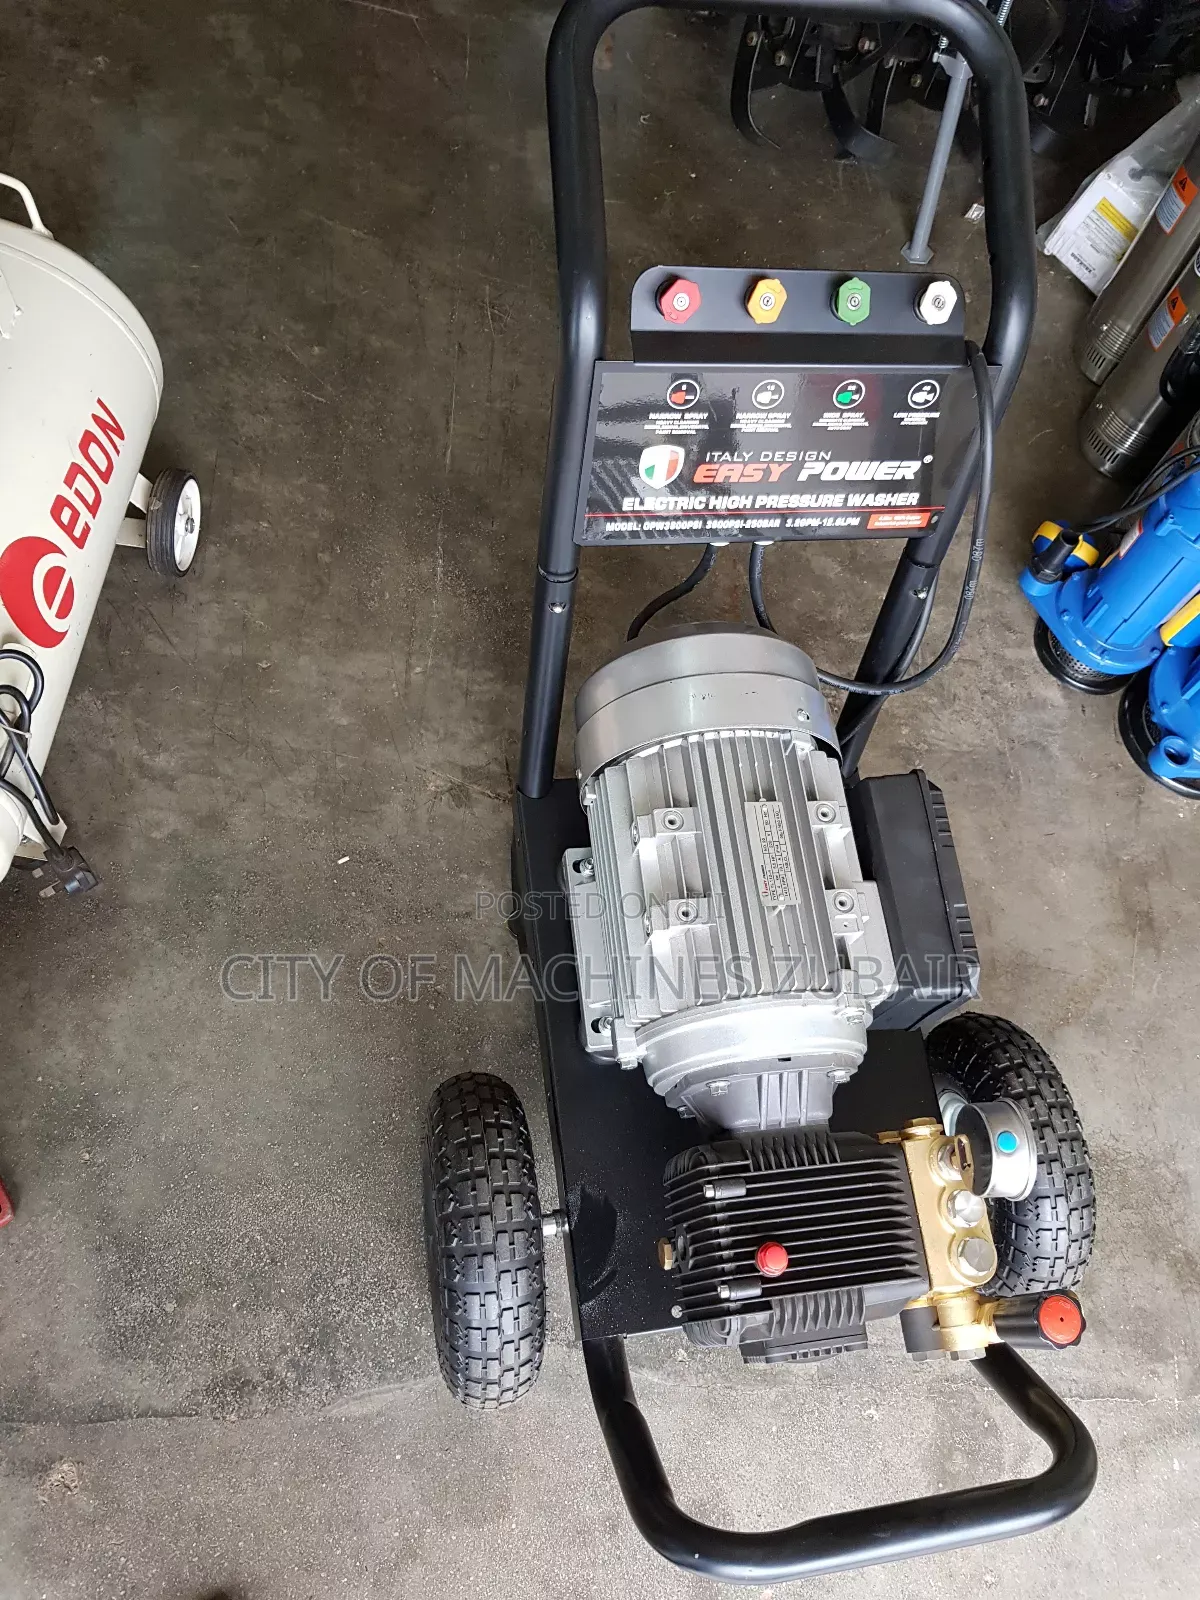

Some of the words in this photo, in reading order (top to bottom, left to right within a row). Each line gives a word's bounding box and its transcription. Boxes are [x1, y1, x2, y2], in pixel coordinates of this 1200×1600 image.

[705, 451, 752, 463] ITALY
[760, 450, 832, 463] DESIGN
[693, 463, 792, 483] EASY
[797, 461, 921, 481] POWER
[622, 497, 706, 511] ELECTRIC
[709, 496, 752, 510] HIGH
[755, 494, 844, 509] PRESSURE
[846, 493, 920, 507] WASHER
